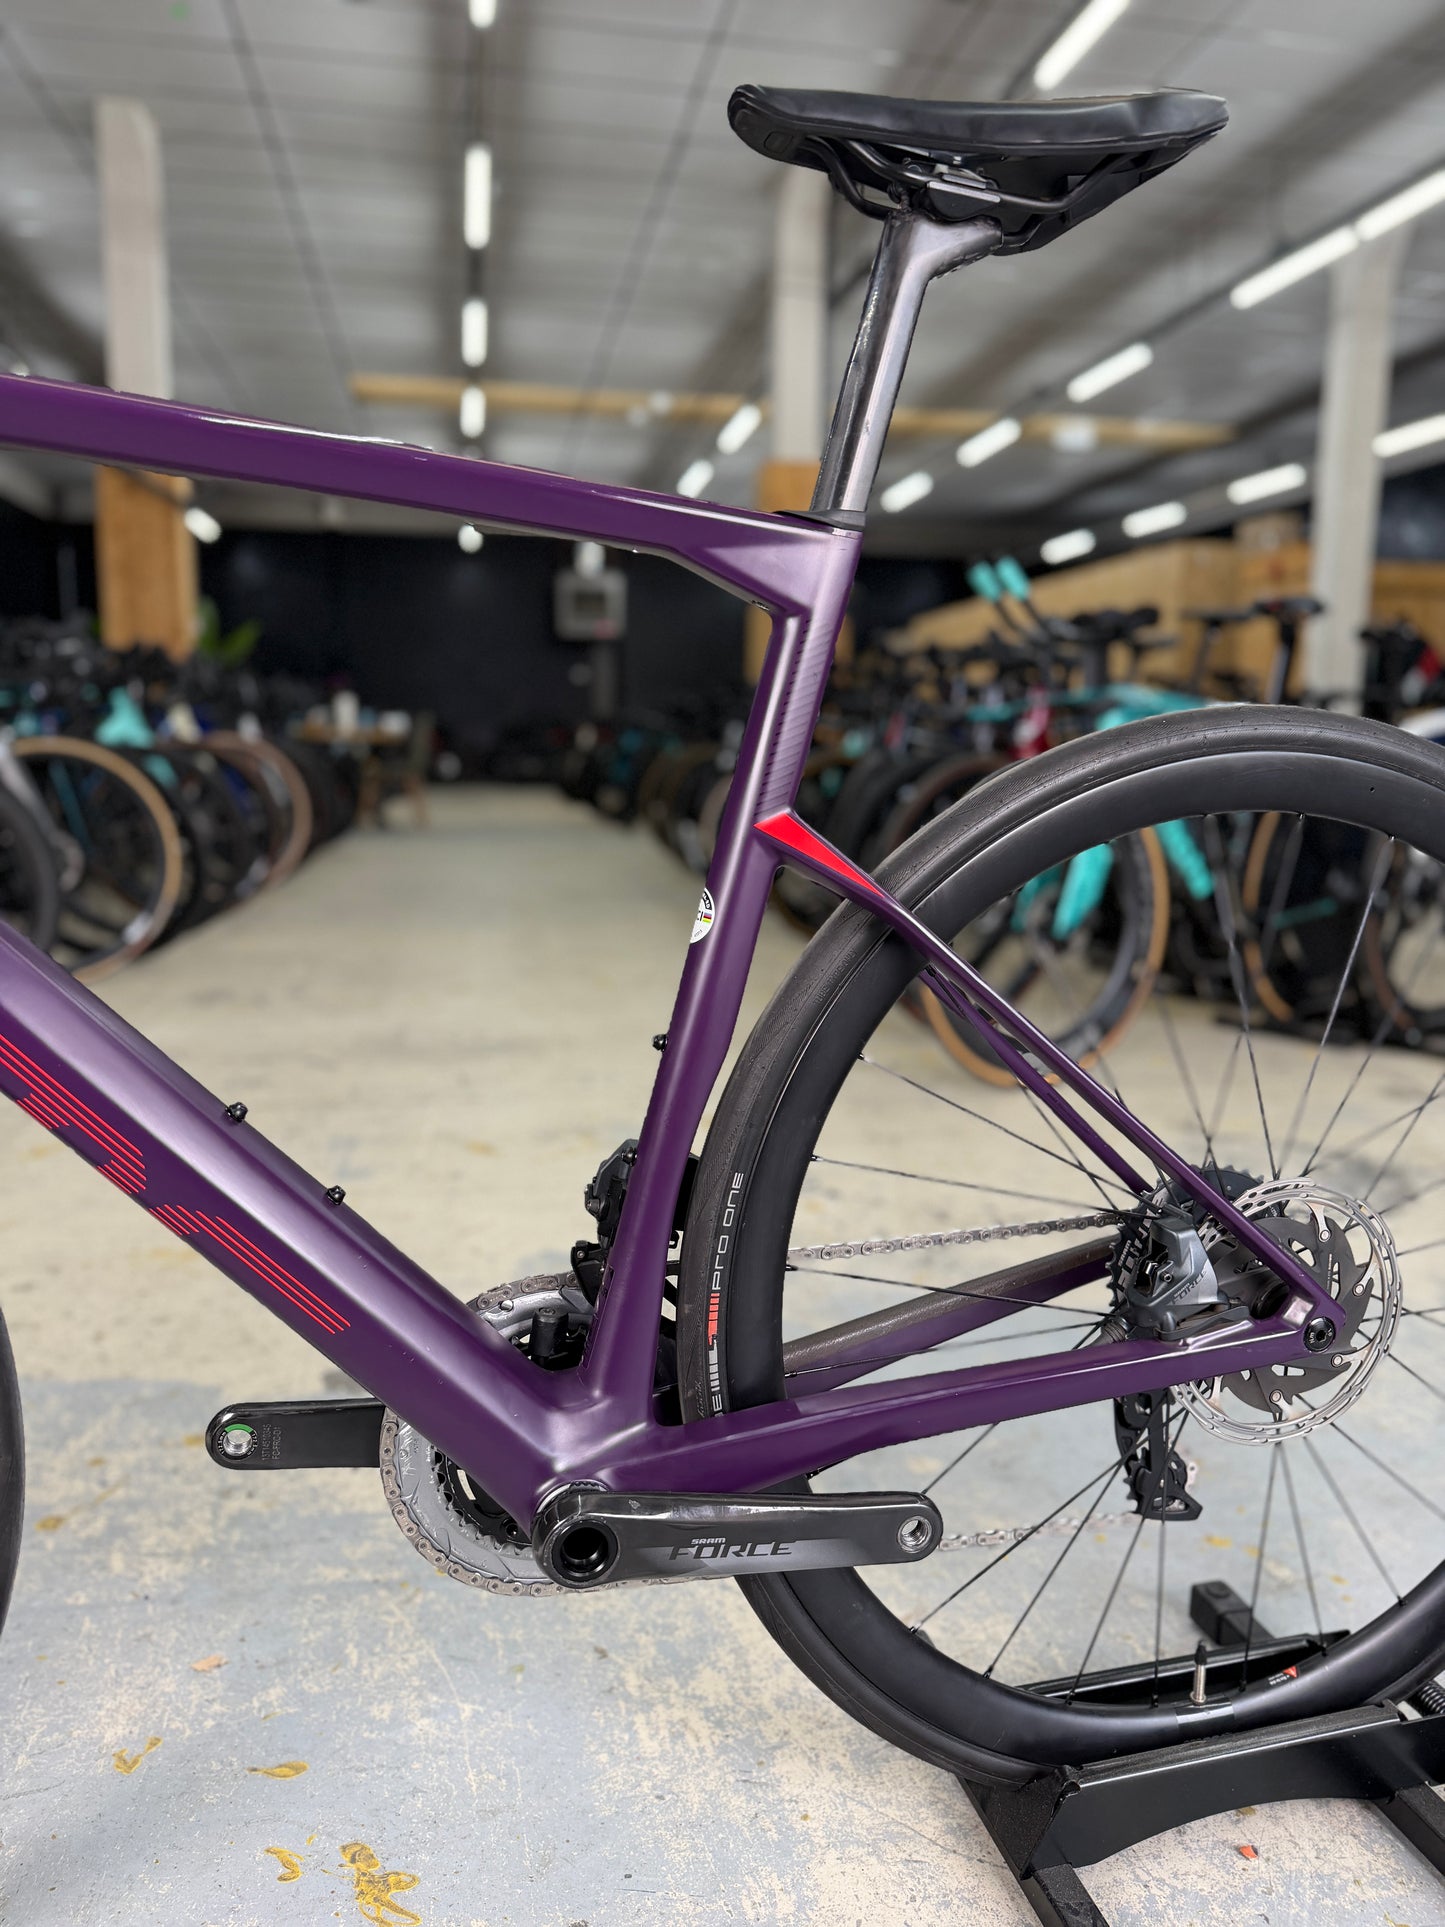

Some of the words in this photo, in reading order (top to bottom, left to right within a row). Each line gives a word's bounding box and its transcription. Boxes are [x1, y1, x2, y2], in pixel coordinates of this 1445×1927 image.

[1118, 1240, 1131, 1267] SRAM
[668, 1540, 797, 1560] FORCE
[691, 1537, 726, 1545] SRAM
